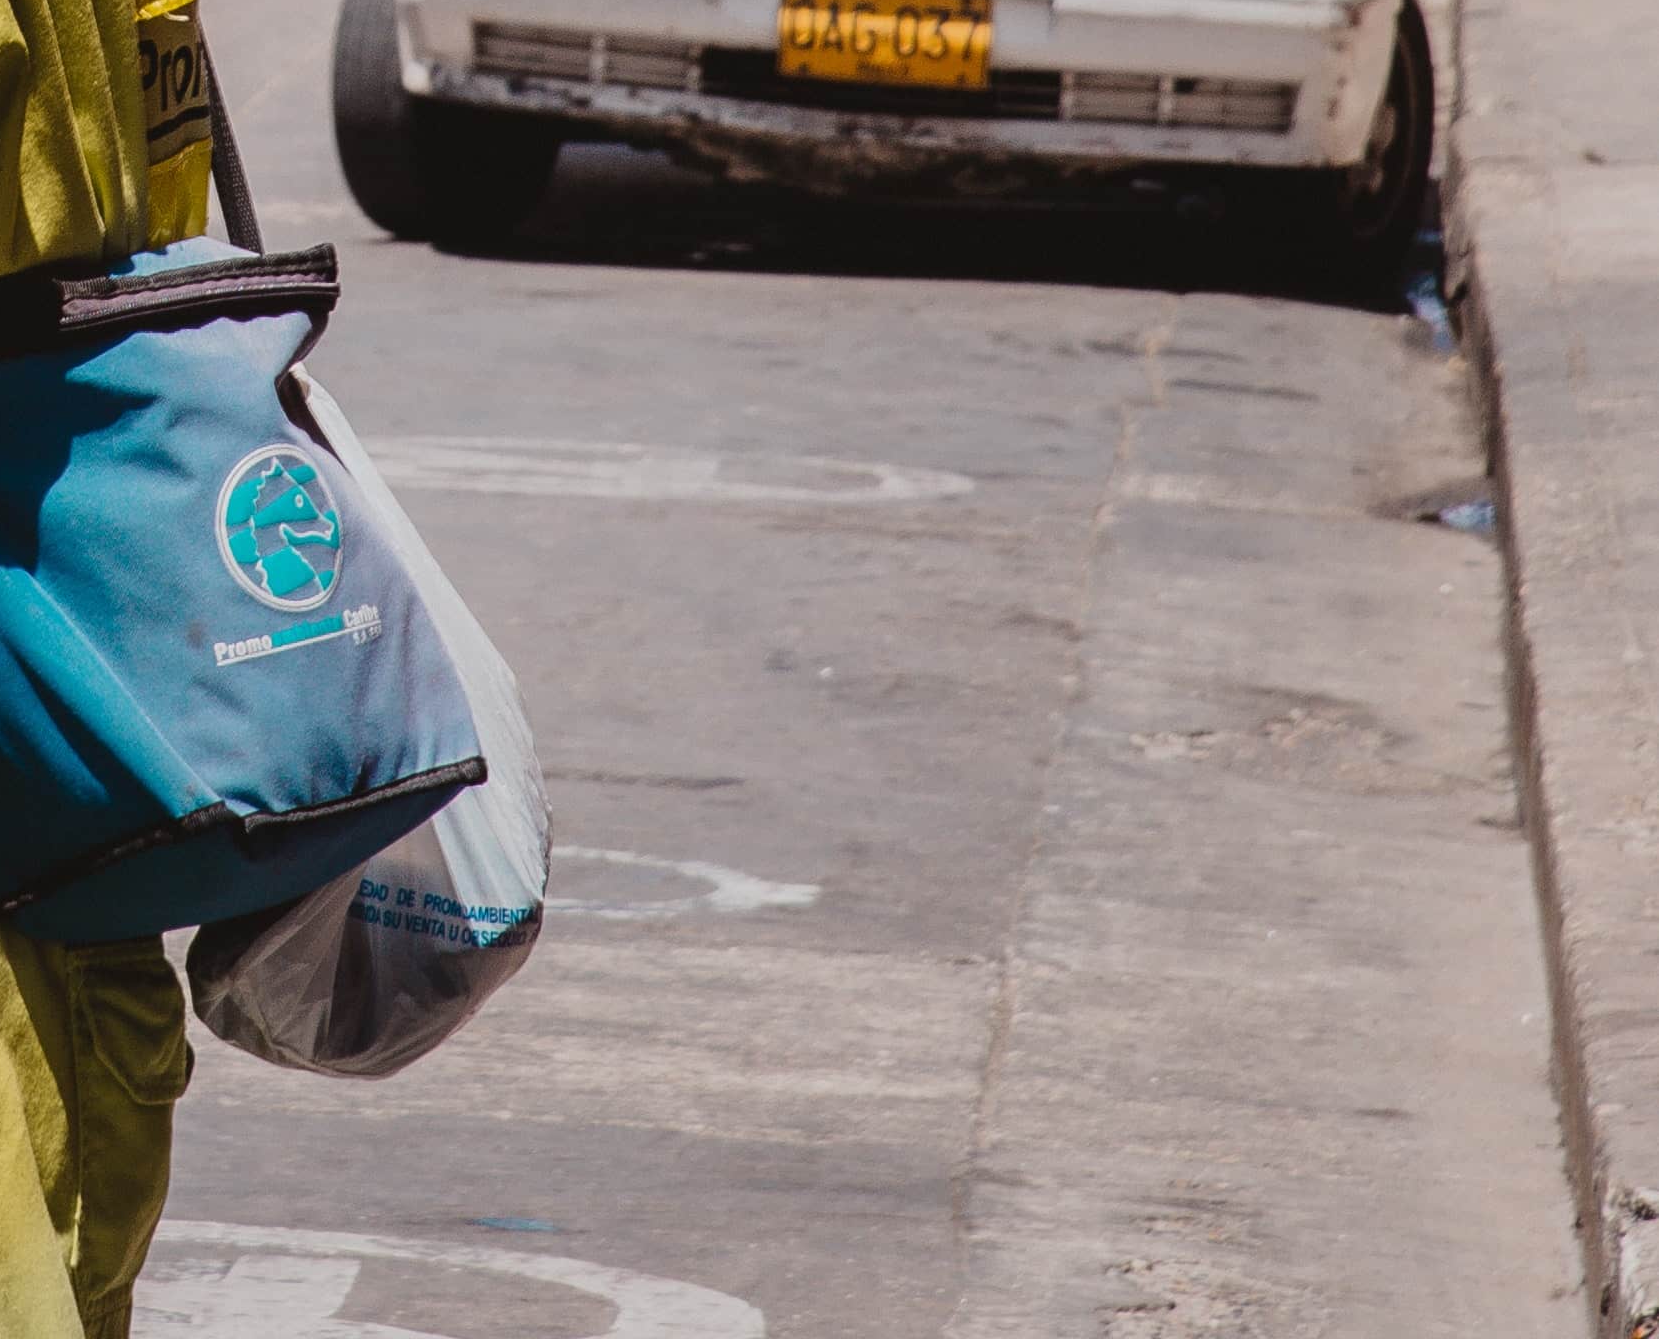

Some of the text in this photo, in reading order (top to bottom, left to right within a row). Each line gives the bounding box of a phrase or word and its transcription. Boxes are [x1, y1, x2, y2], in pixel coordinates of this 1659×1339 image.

[396, 887, 416, 907] DE
[383, 910, 402, 930] SU
[405, 913, 446, 939] VENTA
[448, 925, 460, 942] U
